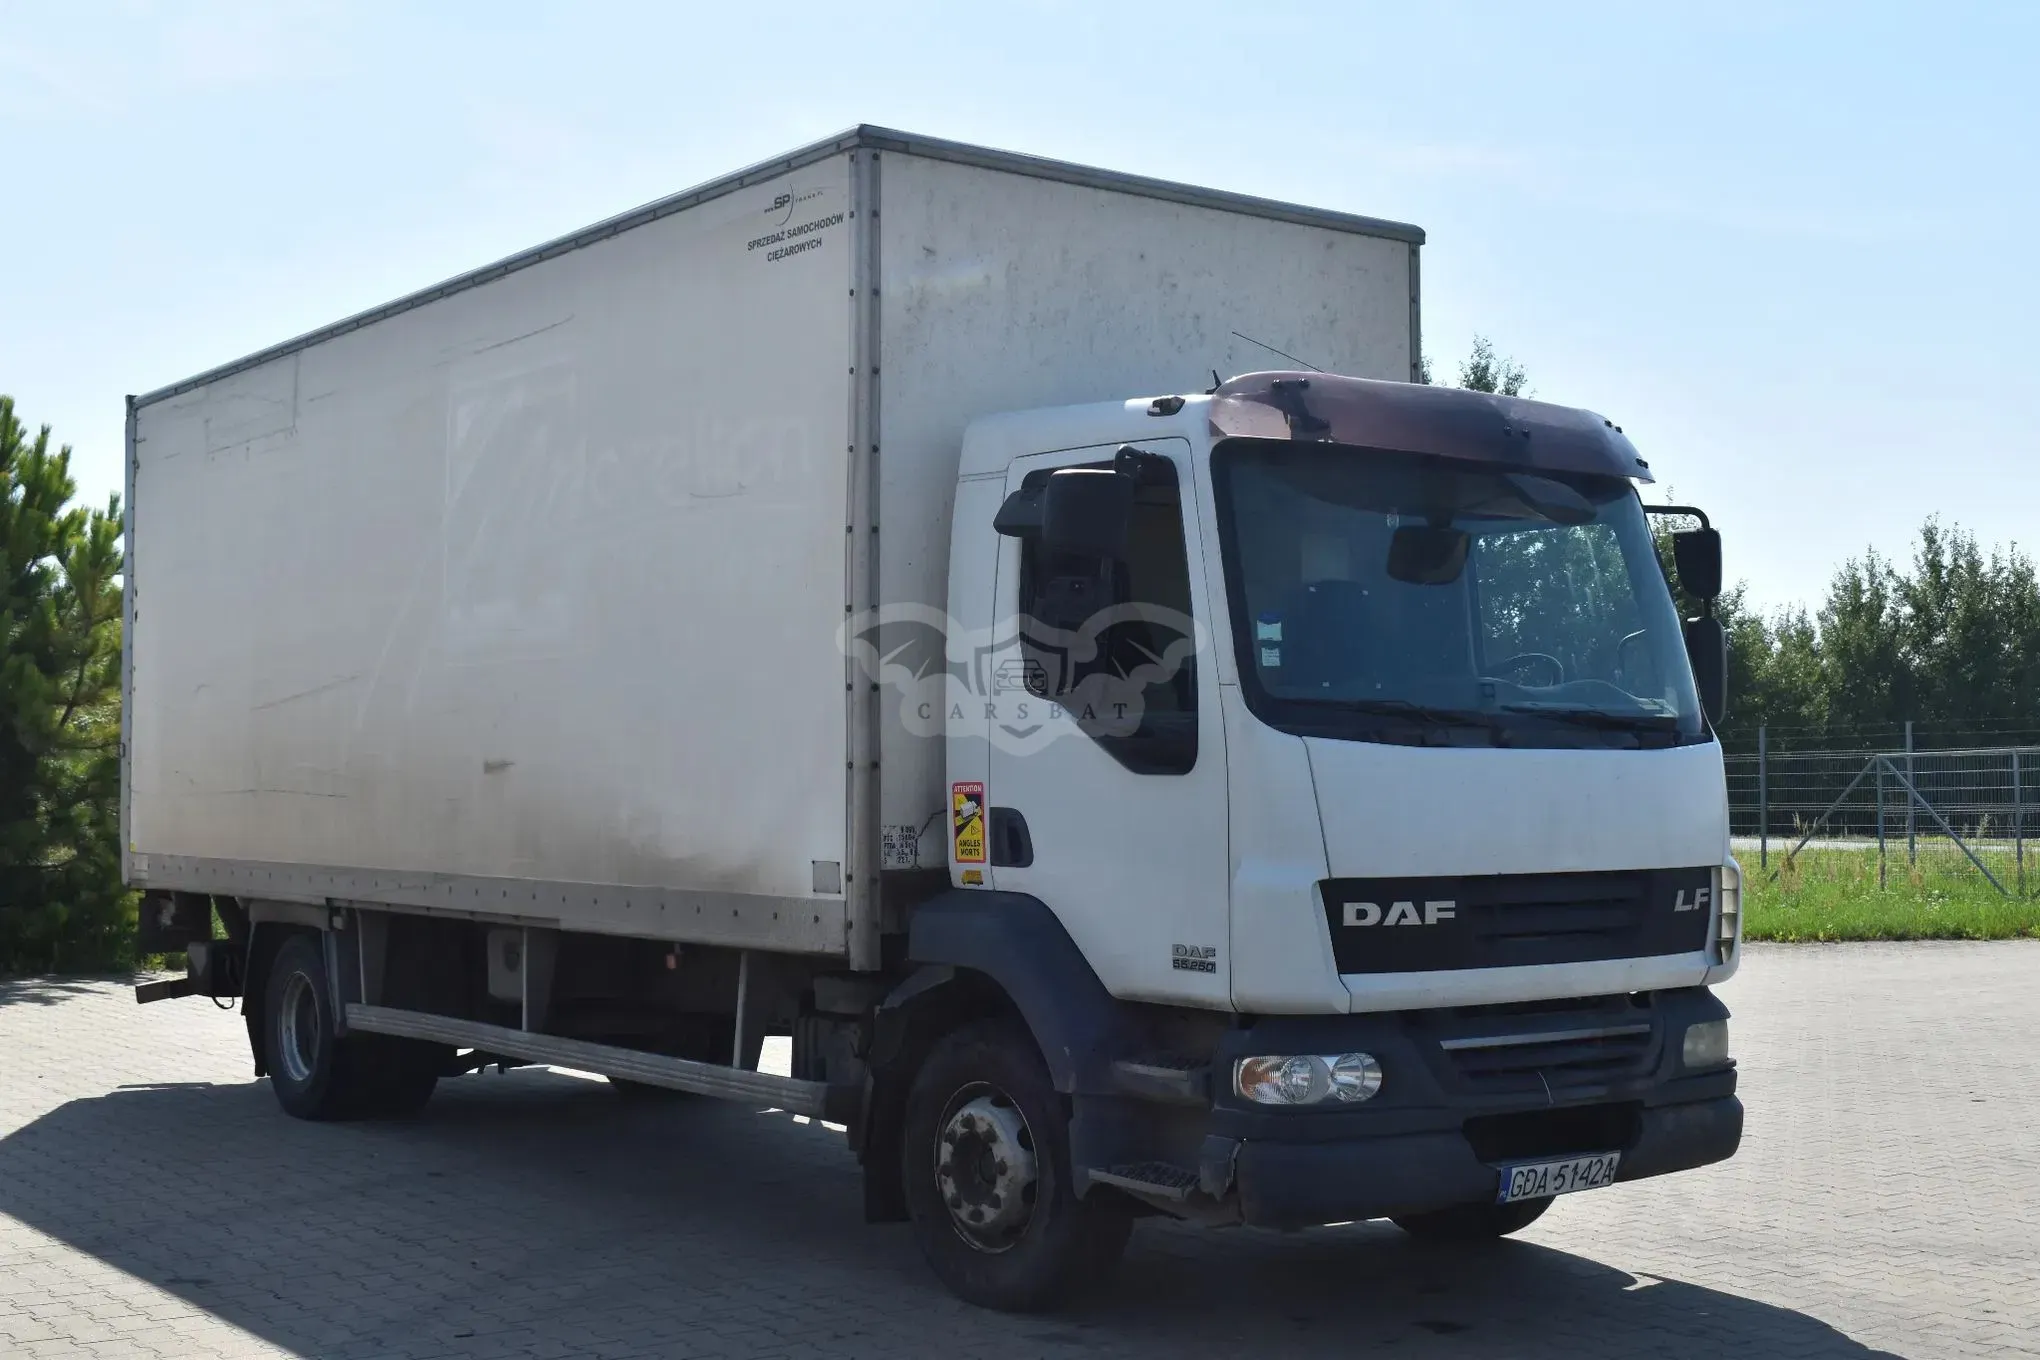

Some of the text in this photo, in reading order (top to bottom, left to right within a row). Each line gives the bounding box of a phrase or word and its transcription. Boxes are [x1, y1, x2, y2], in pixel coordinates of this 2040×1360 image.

[787, 212, 845, 239] SAMOCHODÓW
[767, 237, 822, 262] CIĘŻAROWYCH
[954, 784, 982, 793] ATTENTION
[959, 839, 981, 848] ANGLES
[960, 848, 980, 857] MORTS
[1674, 887, 1710, 912] LF
[1343, 900, 1456, 927] DAF
[1172, 944, 1216, 958] DAF
[1510, 1157, 1615, 1198] GDA 5142A
